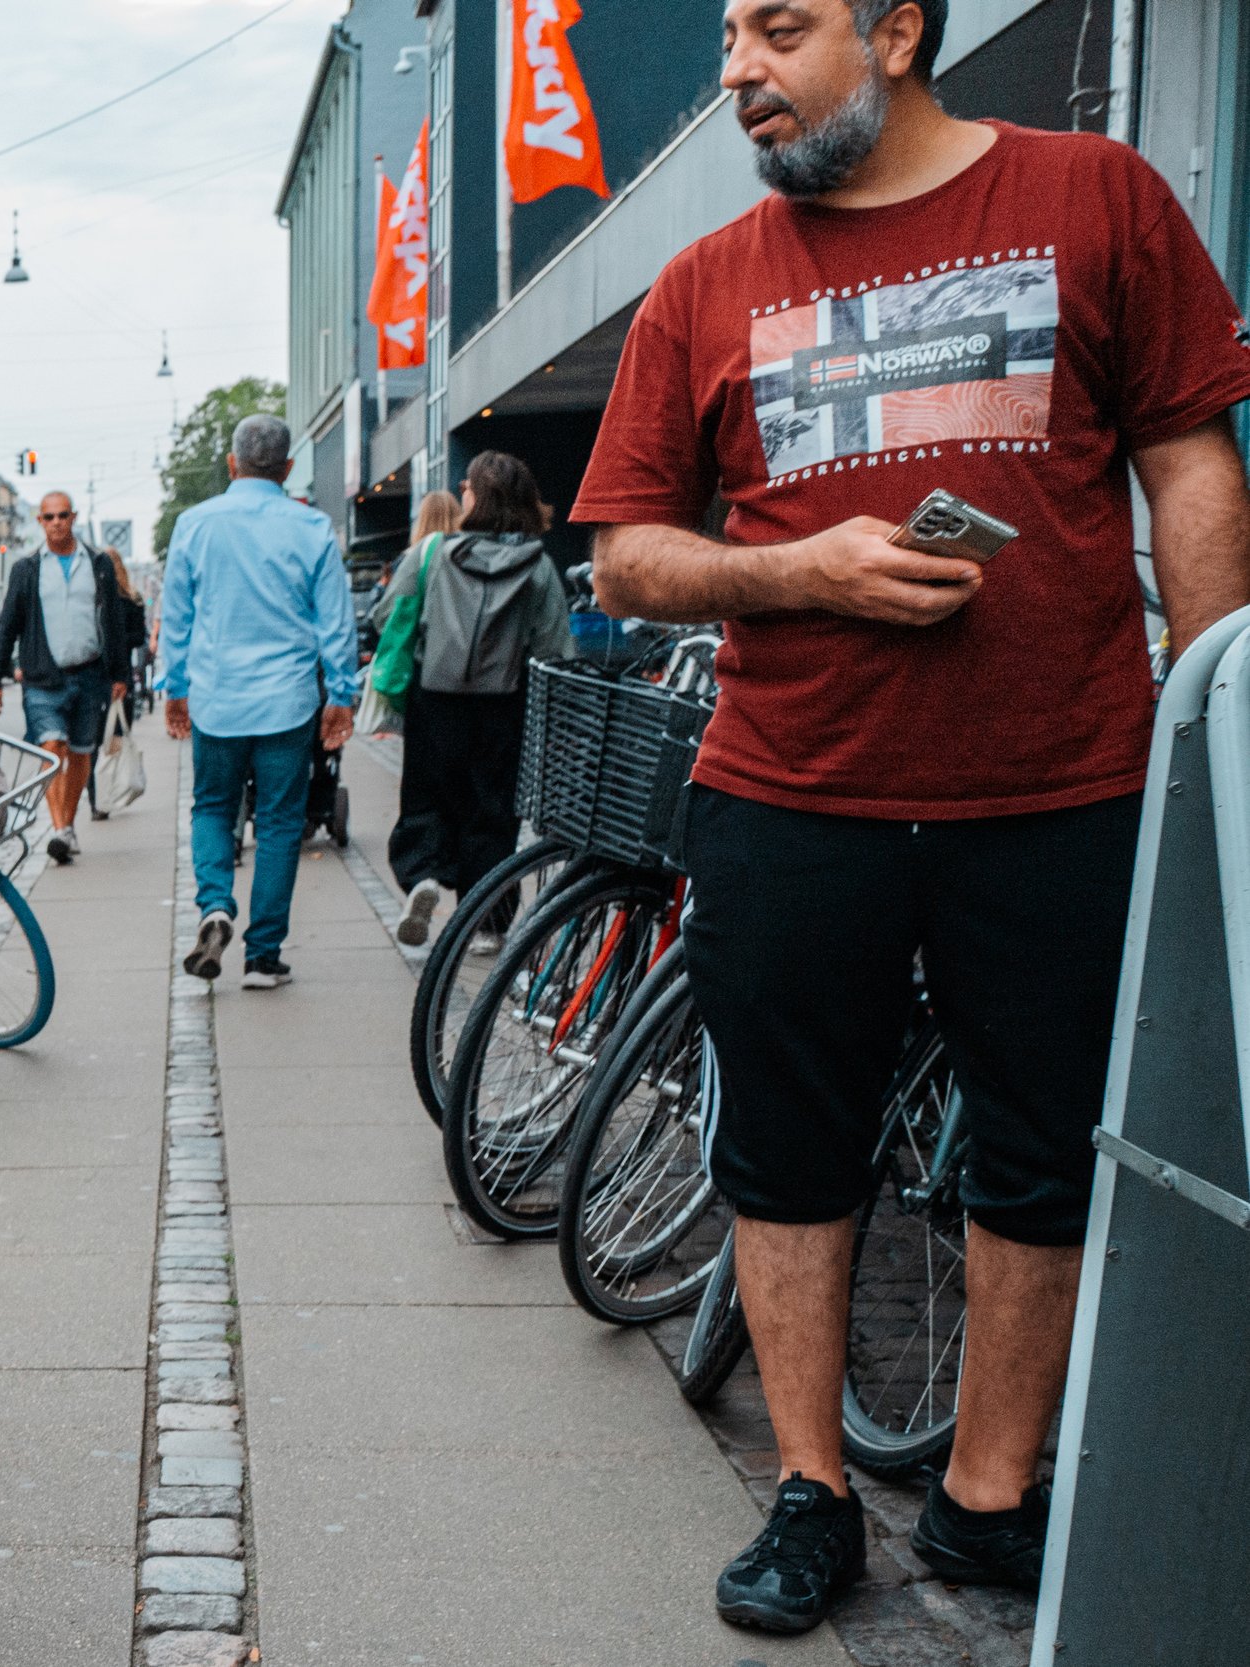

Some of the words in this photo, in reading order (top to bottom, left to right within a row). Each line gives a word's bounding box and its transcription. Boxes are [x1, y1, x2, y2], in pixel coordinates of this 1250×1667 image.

[750, 298, 791, 318] THE
[809, 275, 883, 301] GREAT
[903, 245, 1055, 282] ADVENTURE
[857, 342, 968, 376] NORWAY
[766, 446, 942, 489] GEOGRAPHICAL
[962, 441, 1050, 454] NORWAY
